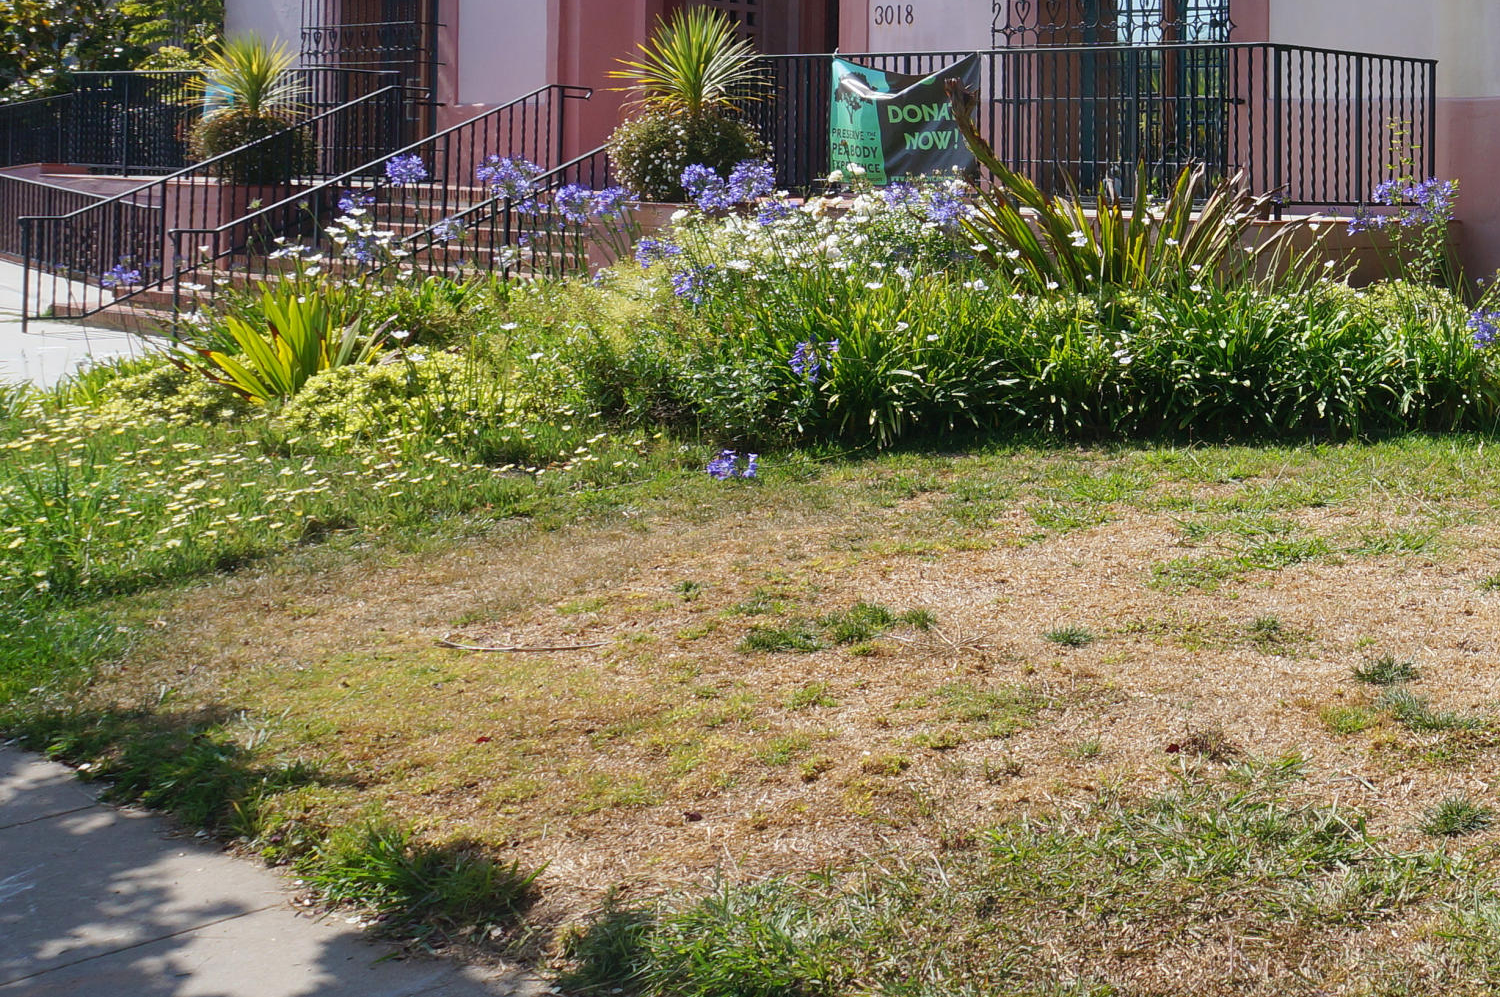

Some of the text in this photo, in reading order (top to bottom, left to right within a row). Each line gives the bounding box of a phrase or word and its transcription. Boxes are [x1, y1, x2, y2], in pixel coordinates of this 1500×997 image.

[874, 4, 914, 26] 3018
[887, 102, 957, 123] DONA
[831, 128, 865, 141] PRESERVE
[904, 128, 959, 150] NOW!
[832, 142, 878, 159] PEABODY
